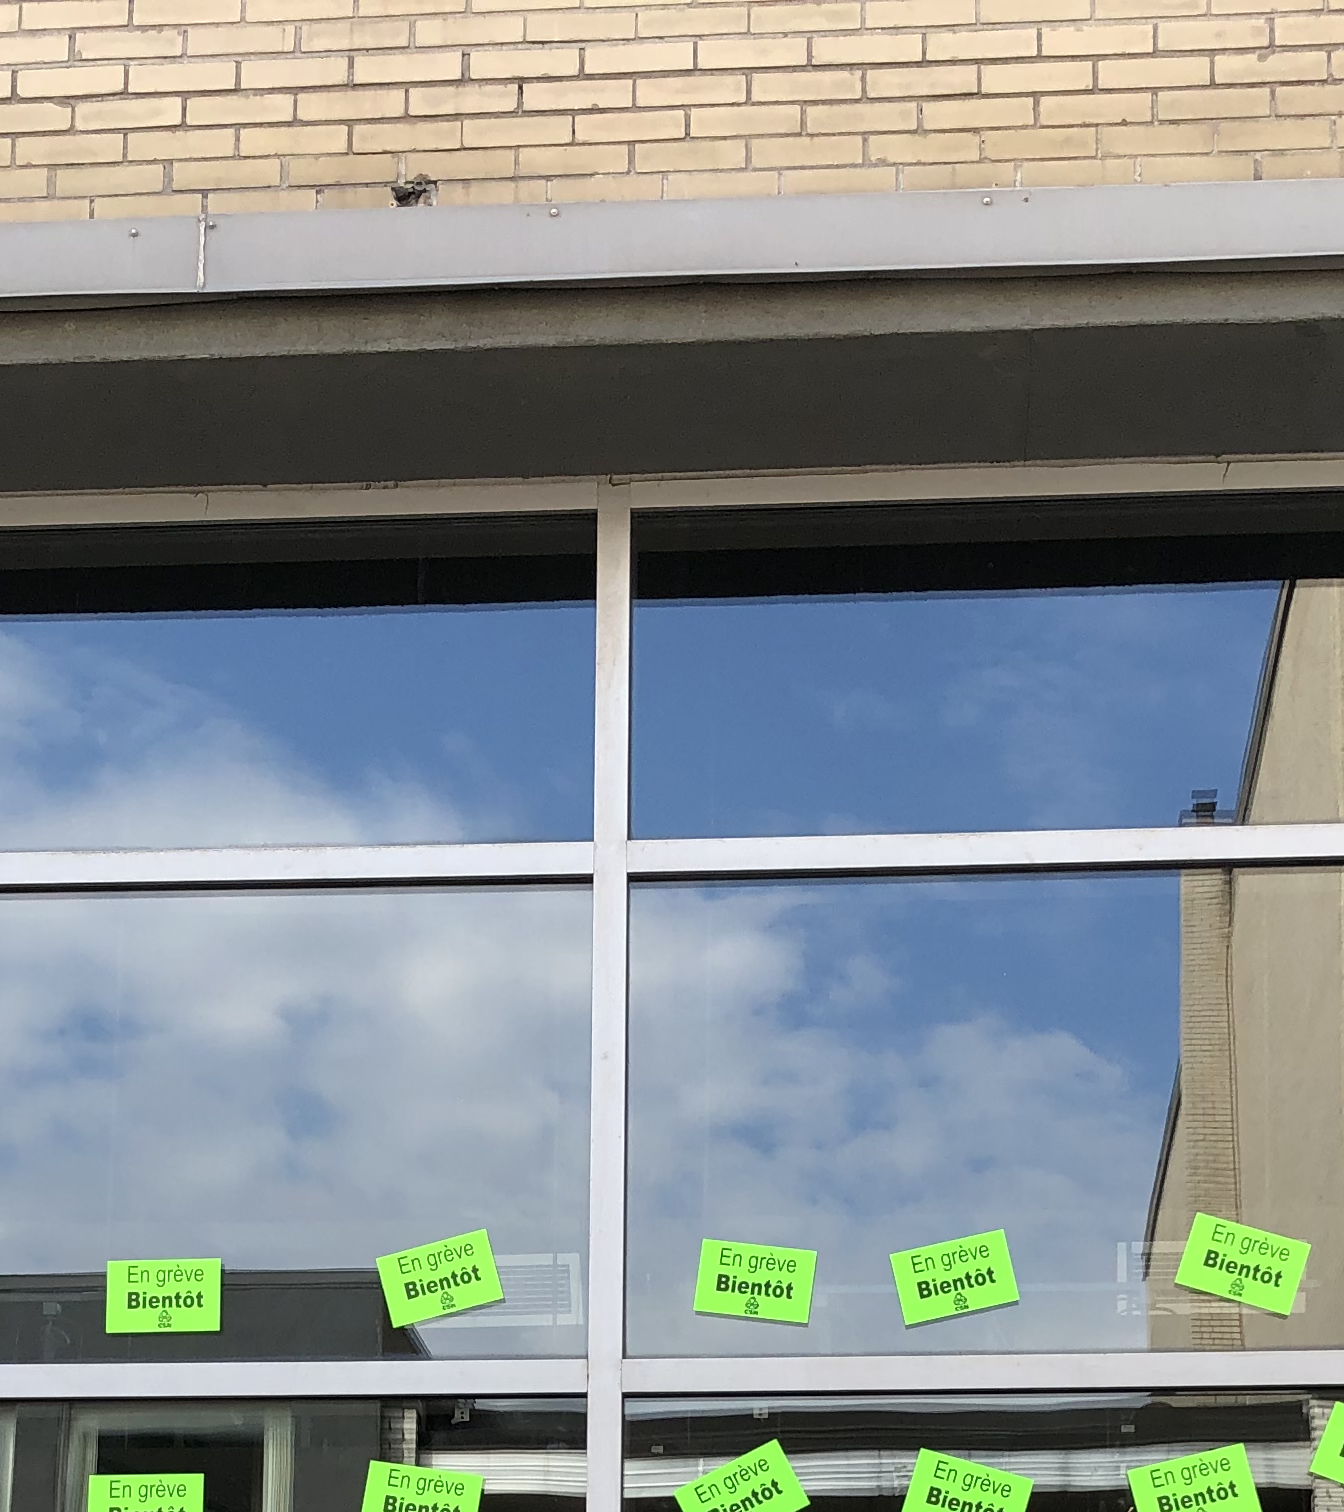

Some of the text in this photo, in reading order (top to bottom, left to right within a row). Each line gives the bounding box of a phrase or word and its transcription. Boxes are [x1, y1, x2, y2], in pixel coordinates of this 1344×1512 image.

[1211, 1223, 1290, 1262] En grève
[397, 1243, 475, 1275] En grève
[719, 1247, 797, 1274] En grève
[1202, 1249, 1283, 1288] Bientôt
[127, 1264, 204, 1288] En grève
[403, 1264, 482, 1301] Bientôt
[715, 1273, 794, 1300] Bientôt
[127, 1290, 204, 1310] Bientôt
[387, 1468, 465, 1497] En grève
[1149, 1457, 1231, 1489] En grève
[109, 1479, 187, 1503] En grève
